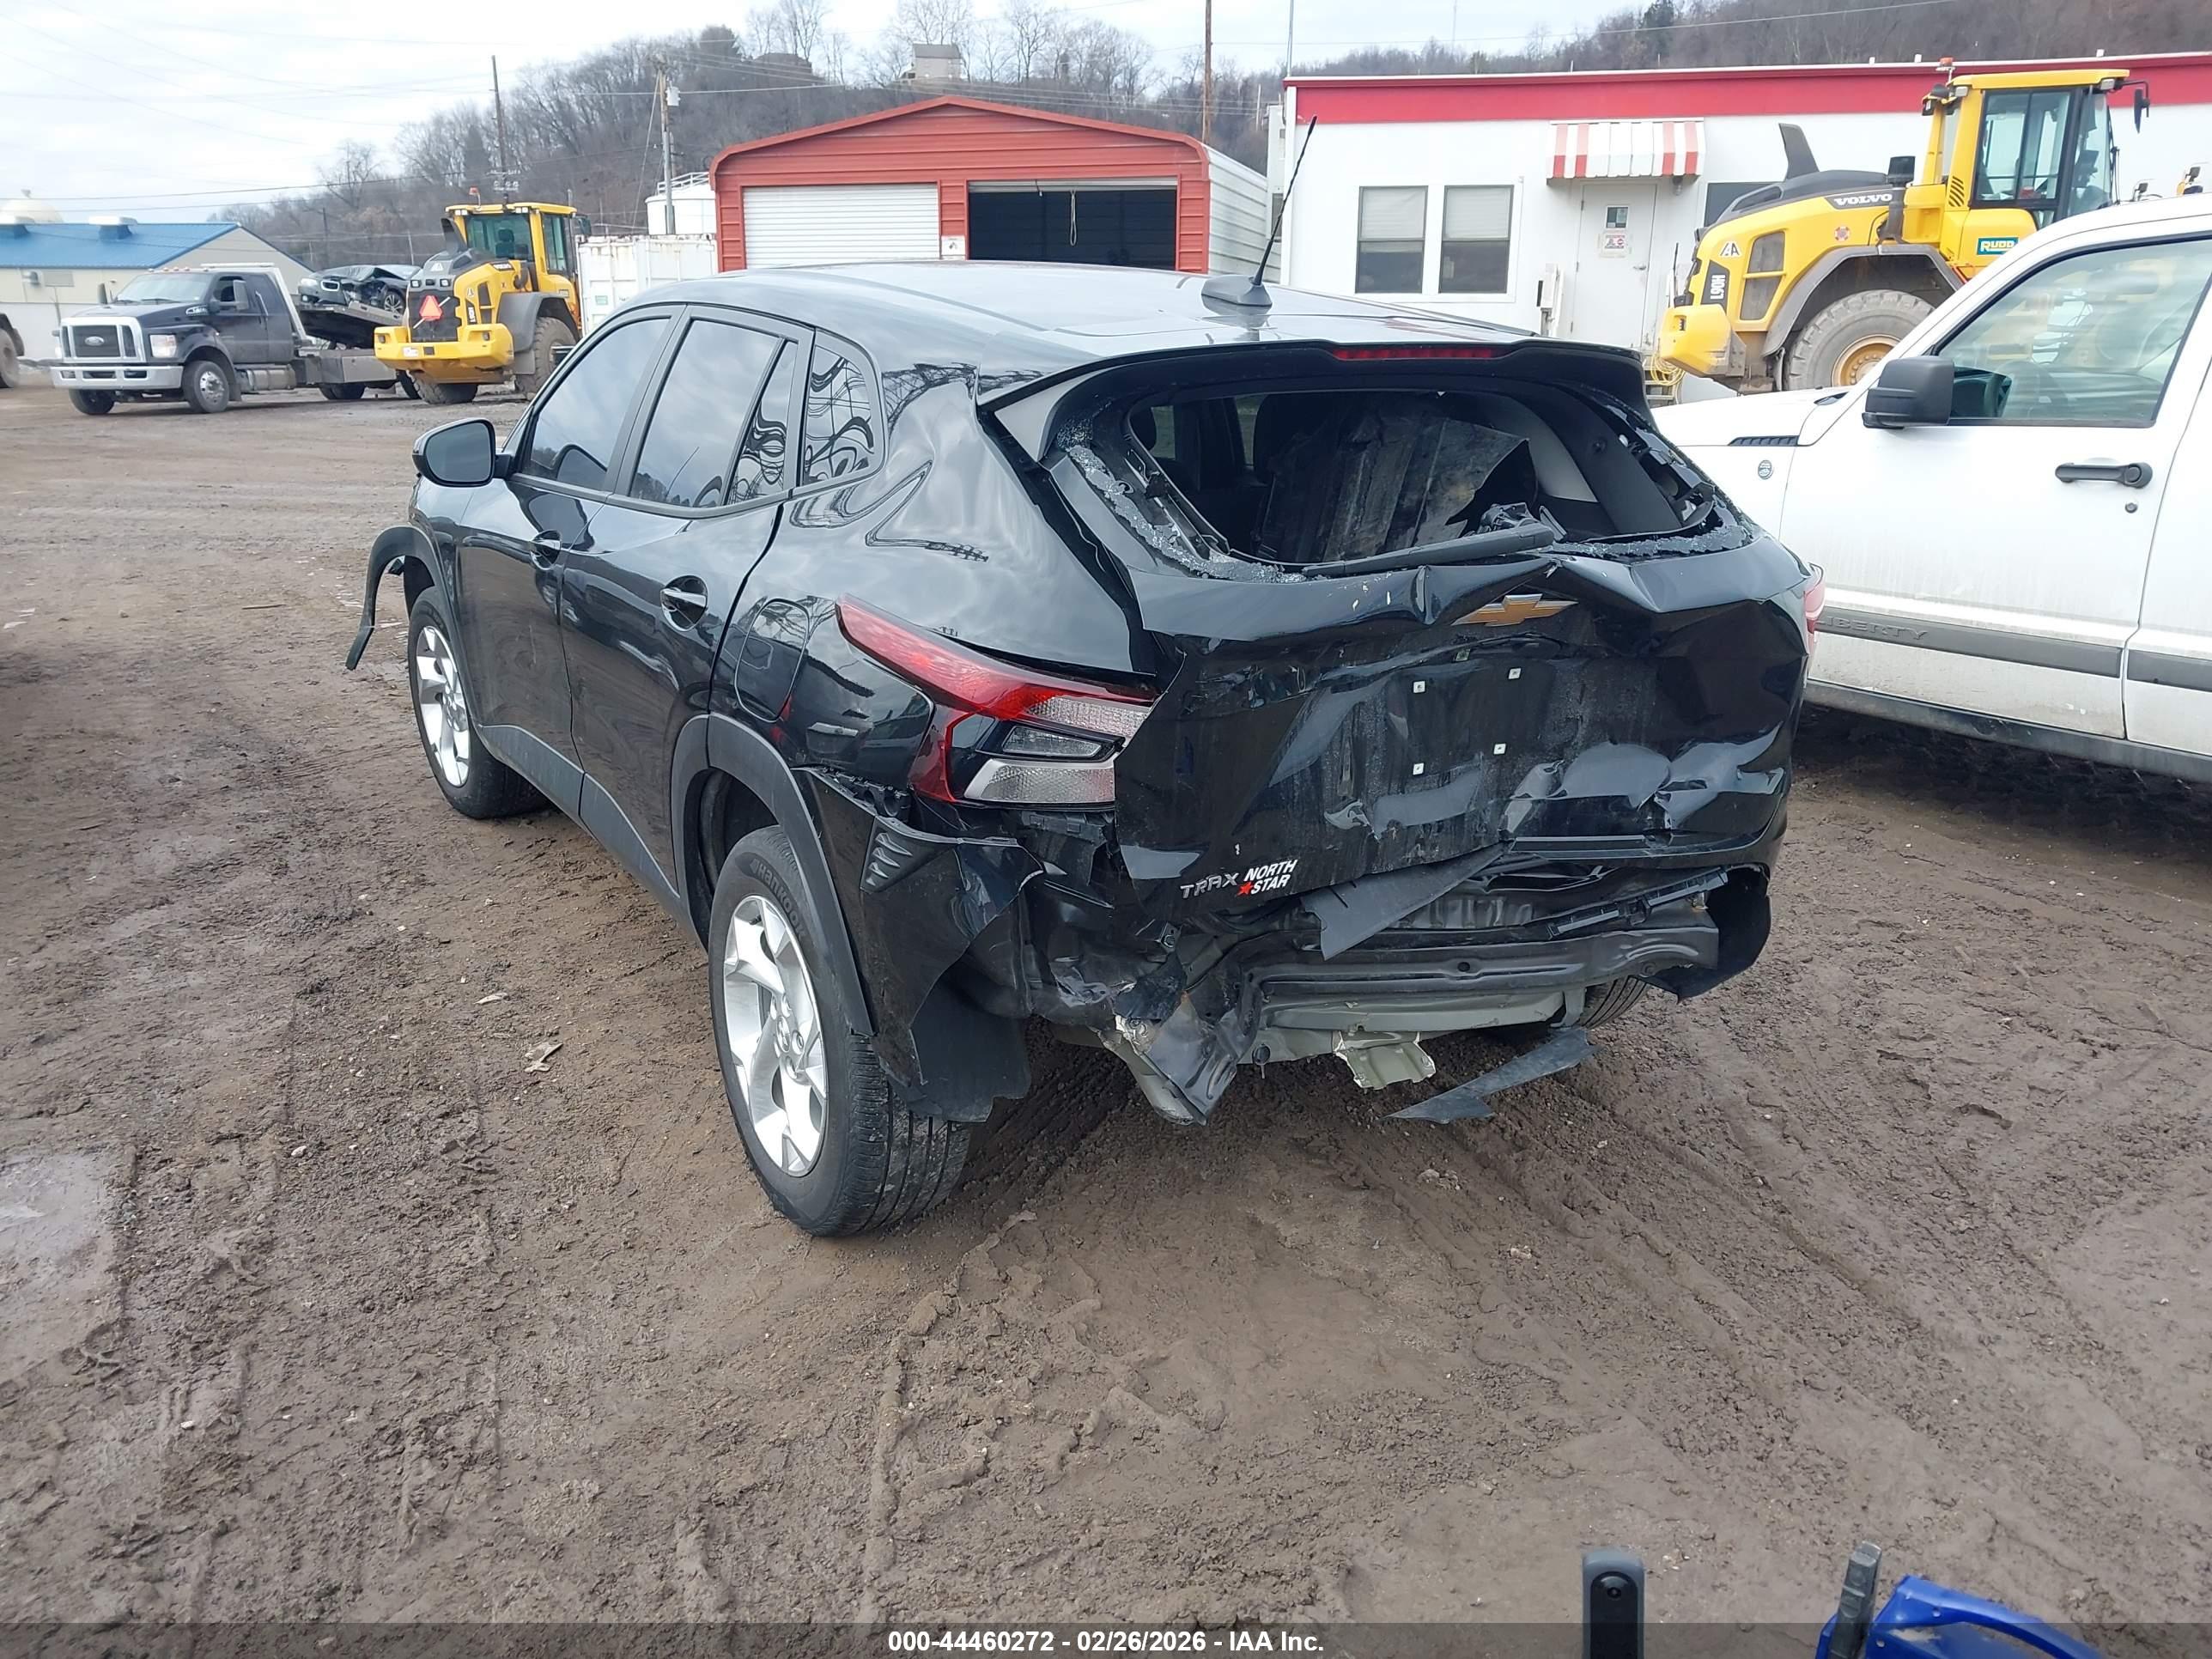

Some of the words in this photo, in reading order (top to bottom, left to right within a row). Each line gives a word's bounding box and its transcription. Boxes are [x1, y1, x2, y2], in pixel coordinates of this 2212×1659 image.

[1834, 193, 1893, 205] VOLVO
[1980, 240, 2015, 252] RUDD
[1710, 275, 1726, 300] L90H
[1244, 859, 1298, 882] NORTH
[1180, 872, 1239, 899] TRAX
[1250, 873, 1291, 895] STAR
